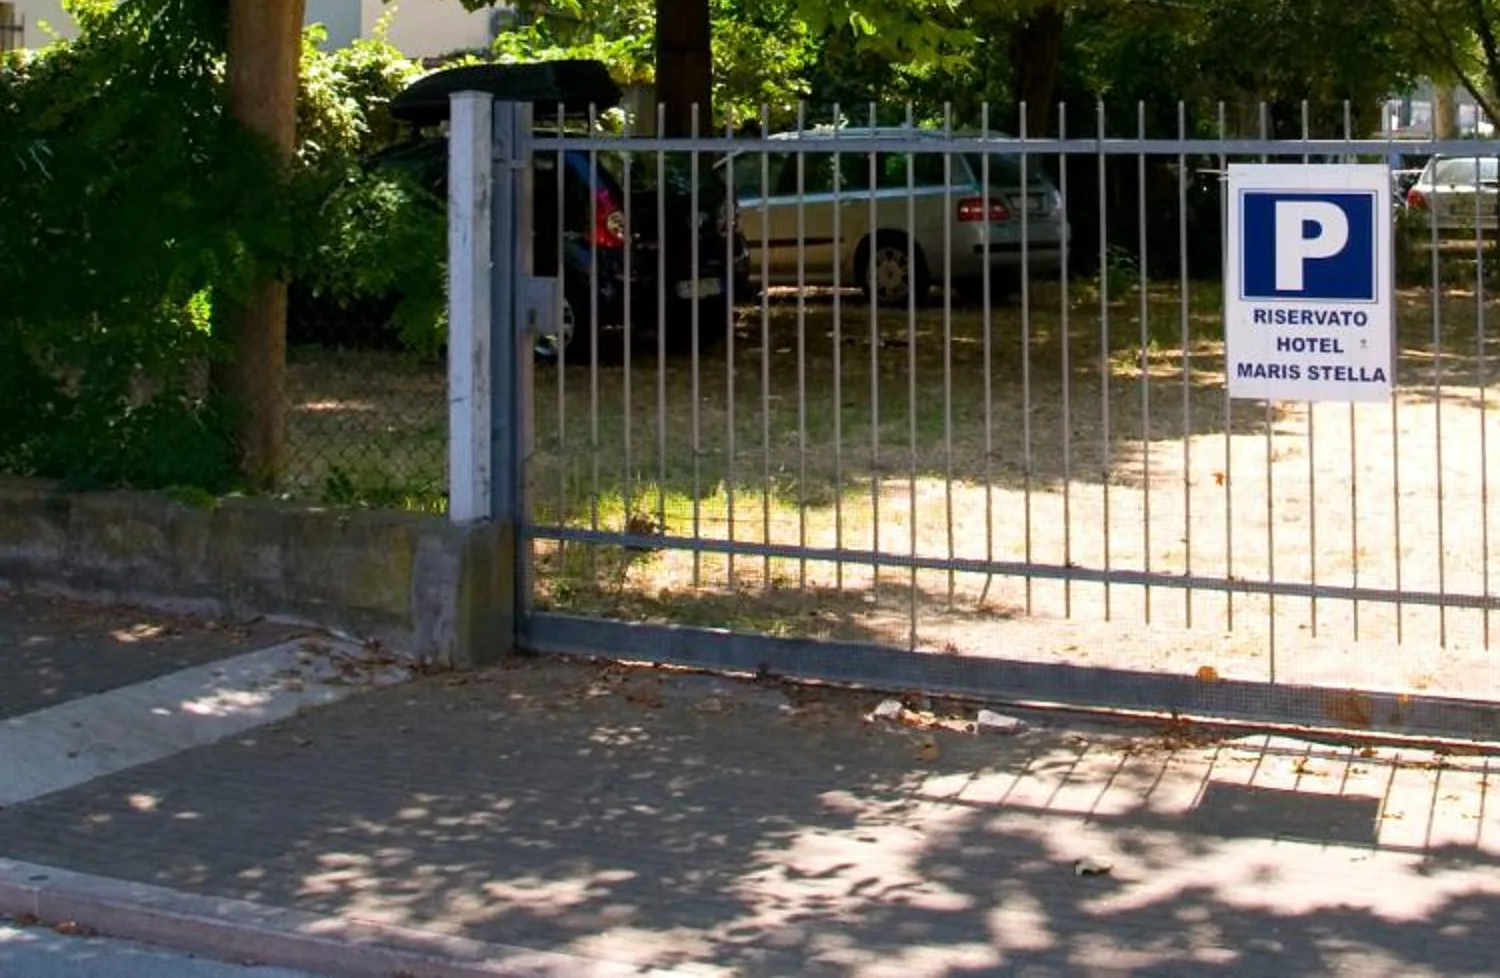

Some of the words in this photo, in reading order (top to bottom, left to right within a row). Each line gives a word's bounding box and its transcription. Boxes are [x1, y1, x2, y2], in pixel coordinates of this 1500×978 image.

[1275, 201, 1349, 291] P
[1253, 308, 1368, 327] RISERVATO
[1276, 336, 1345, 354] HOTEL
[1237, 362, 1301, 381] MARIS
[1307, 365, 1387, 383] STELLA
